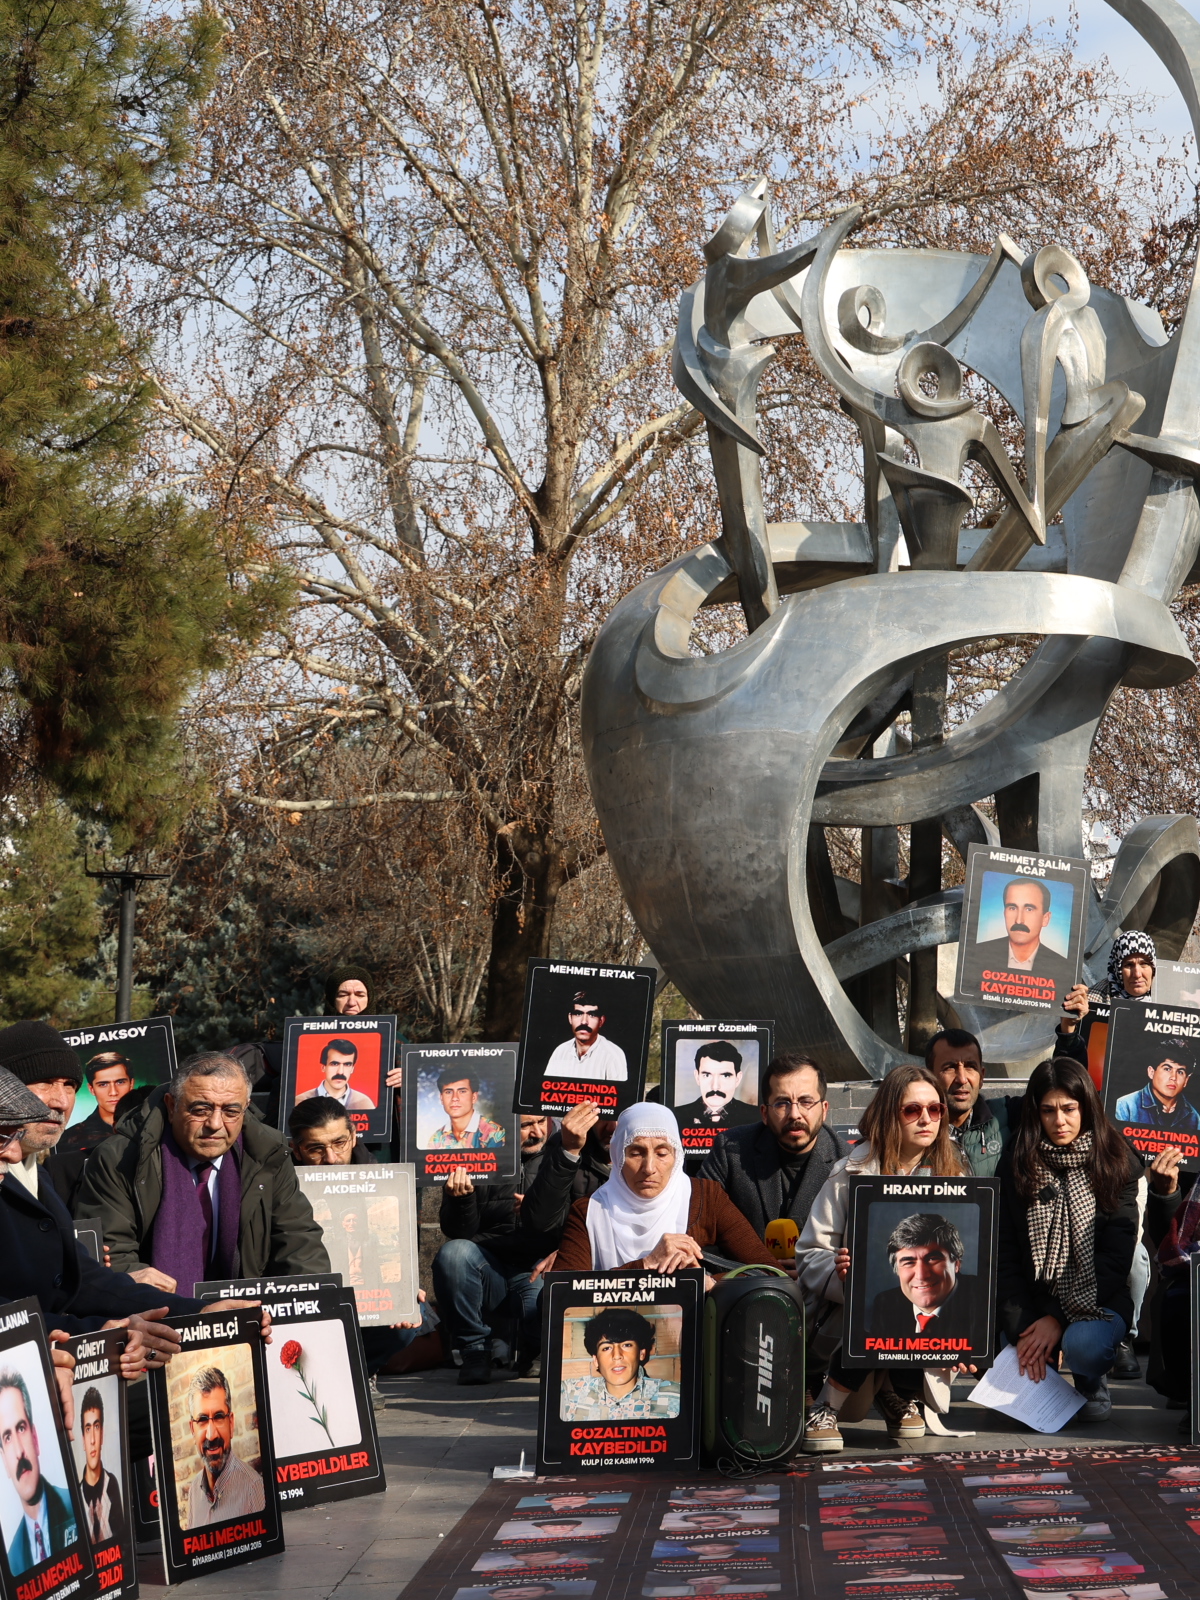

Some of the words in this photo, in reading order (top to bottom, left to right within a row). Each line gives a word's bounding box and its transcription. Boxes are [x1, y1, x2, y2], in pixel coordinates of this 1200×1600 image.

[989, 851, 1036, 867] MEHMET
[1038, 859, 1071, 872] SALİM
[1015, 867, 1046, 877] ACAR
[549, 964, 598, 977] MEHMET
[599, 969, 636, 980] ERTAK
[1172, 965, 1183, 973] M.
[981, 981, 1056, 1001] KAYBEDİLDİ
[1144, 1008, 1159, 1019] M.
[302, 1019, 338, 1031] FEHMİ
[340, 1021, 378, 1030] TOSUN
[678, 1024, 717, 1032] MEHMET
[718, 1023, 758, 1033] ÖZDEMİR
[1144, 1021, 1200, 1039] AKDENİZ
[97, 1025, 148, 1043] AKSOY
[419, 1049, 459, 1058] TURGUT
[461, 1047, 504, 1057] YENİSOY
[304, 1171, 357, 1182] MEHMET
[359, 1168, 394, 1179] SALİH
[323, 1182, 376, 1194] AKDENİZ
[883, 1184, 931, 1195] HRANT
[934, 1181, 967, 1196] DİNK
[572, 1278, 635, 1290] MEHMET
[638, 1274, 676, 1292] ŞİRİN
[592, 1291, 655, 1303] BAYRAM
[292, 1298, 321, 1315] İPEK
[178, 1321, 211, 1343] TAHİR
[213, 1316, 239, 1341] ELÇİ
[76, 1339, 106, 1359] CÜNEYT
[865, 1338, 903, 1350] FAİLİ
[878, 1352, 910, 1361] İSTANBUL
[914, 1353, 921, 1361] 19
[922, 1353, 941, 1361] OCAK
[942, 1353, 960, 1361] 2007
[75, 1359, 110, 1380] AYDINLAR
[756, 1323, 774, 1428] SHILE
[569, 1439, 668, 1456] KAYBEDİLDİ
[581, 1458, 600, 1466] KULP
[604, 1458, 614, 1466] 02
[614, 1457, 638, 1466] KASIM
[639, 1456, 655, 1465] 1996
[287, 1487, 304, 1499] 1994
[183, 1535, 215, 1555] FAİLİ
[192, 1551, 223, 1567] DİYARBAKIR
[226, 1548, 234, 1558] 28
[233, 1544, 251, 1556] KASIM
[250, 1541, 262, 1551] 2015
